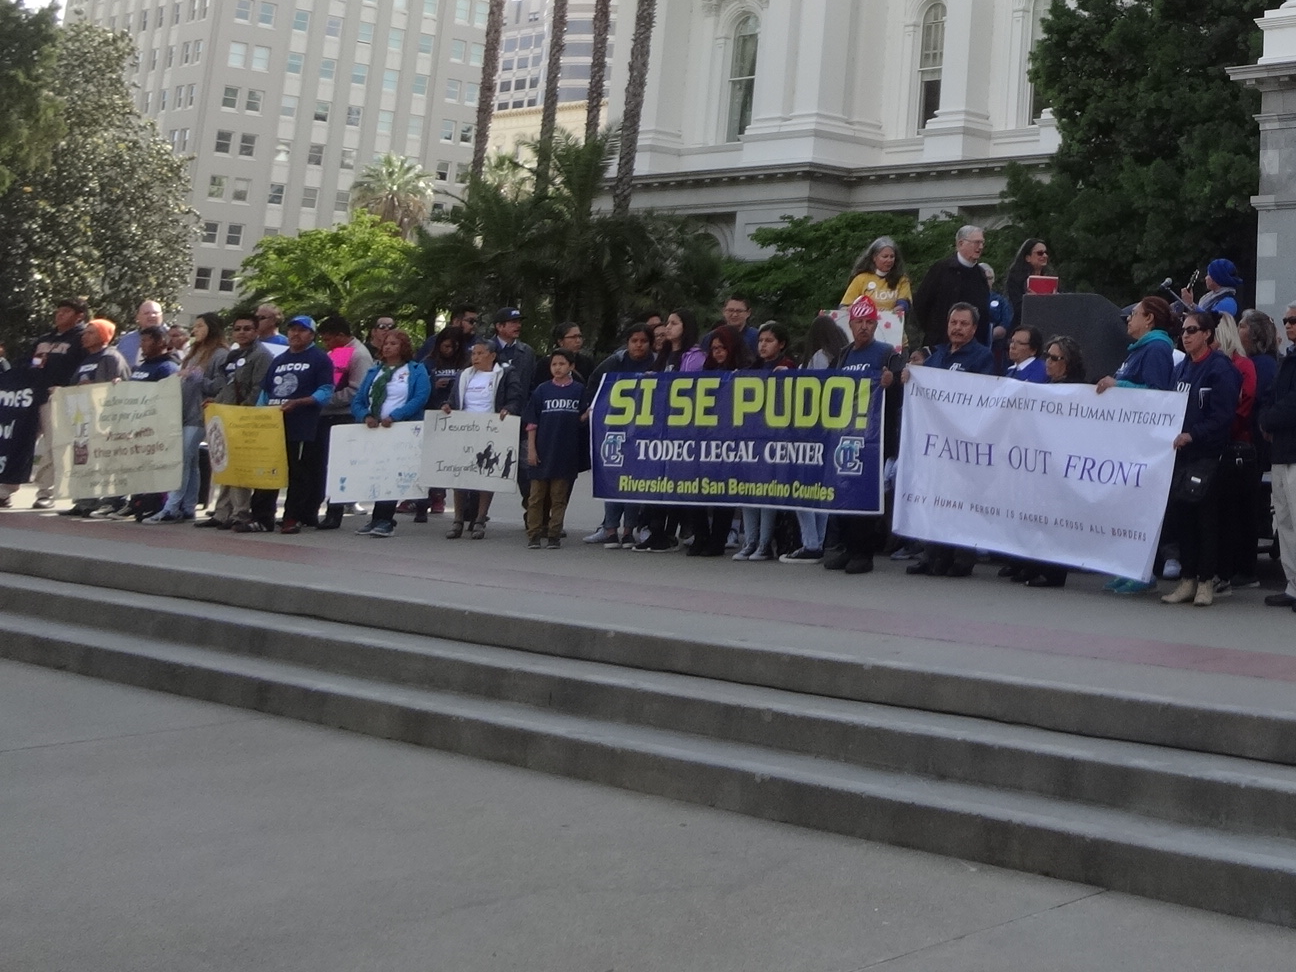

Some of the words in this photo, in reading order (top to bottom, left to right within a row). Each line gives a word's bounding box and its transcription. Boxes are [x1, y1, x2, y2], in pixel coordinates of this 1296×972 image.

[544, 398, 580, 410] TODEC
[604, 378, 657, 425] SI
[667, 377, 721, 426] SE
[733, 376, 872, 429] PUDO!
[1068, 403, 1115, 422] HUMAN
[1117, 408, 1176, 427] INTEGRITY
[635, 439, 696, 464] TODEC
[699, 440, 759, 464] LEGAL
[764, 442, 825, 467] CENTER
[923, 433, 995, 467] FAITH
[1008, 445, 1052, 475] OUT
[1063, 454, 1148, 488] FRONT
[619, 475, 675, 495] Riverside
[677, 479, 700, 495] and
[701, 478, 727, 496] San
[729, 478, 791, 499] Bernardino
[792, 481, 836, 502] Counties
[902, 493, 927, 504] ERY
[970, 503, 1001, 517] PERSON
[1006, 508, 1015, 518] IS
[1019, 511, 1049, 525] SACRED
[1054, 517, 1084, 531] ACROSS
[1089, 524, 1106, 535] ALL
[1111, 527, 1147, 542] BORDERS
